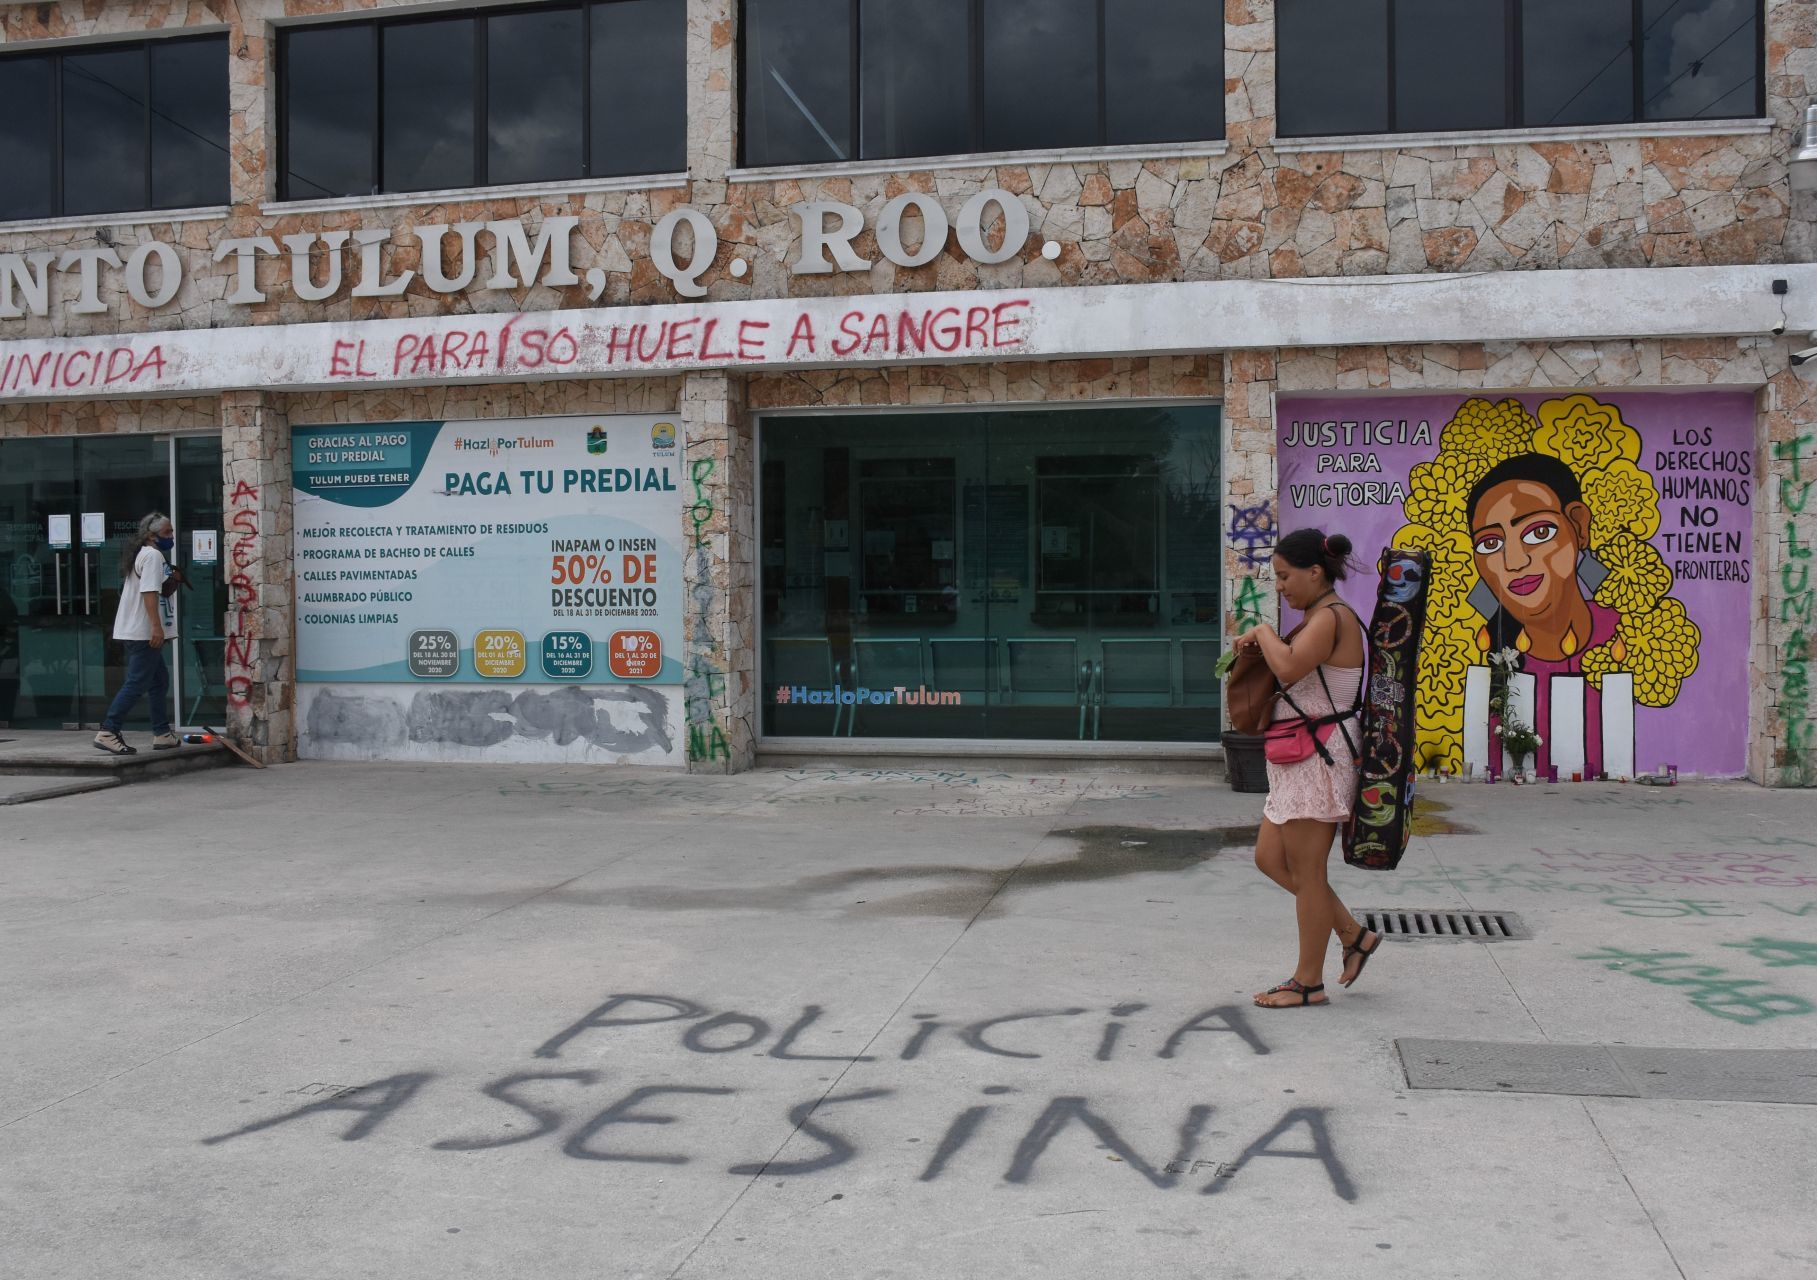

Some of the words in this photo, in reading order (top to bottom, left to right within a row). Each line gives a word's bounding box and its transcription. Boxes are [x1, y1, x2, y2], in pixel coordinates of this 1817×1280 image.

[0, 240, 182, 318] NTO
[213, 215, 607, 304] TULUM,
[649, 208, 748, 298] Q.
[791, 188, 1061, 274] ROO.
[329, 339, 377, 378] EL
[608, 317, 769, 364] HUELE
[786, 312, 816, 358] A
[832, 300, 1030, 357] SANGRE
[308, 437, 356, 449] GRACIAS
[359, 435, 372, 447] AL
[375, 434, 407, 446] PAGO
[1283, 420, 1432, 447] JUSTICIA
[1673, 427, 1712, 446] LOS
[309, 452, 322, 463] DE
[324, 452, 338, 463] TU
[342, 450, 385, 462] PREDIAL
[1317, 453, 1382, 473] PARA
[1655, 450, 1750, 476] DERECHOS
[309, 475, 342, 485] TULUM
[344, 474, 376, 484] PUEDE
[378, 473, 410, 483] TENER
[445, 471, 512, 496] PAGA
[520, 470, 554, 494] TU
[563, 467, 676, 493] PREDIAL
[1290, 481, 1407, 509] VICTORIA
[1662, 476, 1750, 506] HUMANOS
[1680, 505, 1719, 528] NO
[303, 528, 336, 538] MEJOR
[339, 526, 393, 537] RECOLECTA
[396, 526, 402, 536] Y
[405, 525, 477, 536] TRATAMIENTO
[480, 524, 493, 534] DE
[496, 523, 549, 534] RESIDUOS
[552, 539, 601, 552] INAPAM
[604, 538, 615, 551] O
[619, 538, 656, 551] INSEN
[1661, 531, 1741, 553] TIENEN
[303, 549, 361, 559] PROGRAMA
[364, 549, 377, 558] DE
[380, 548, 420, 558] BACHEO
[424, 547, 436, 557] DE
[440, 546, 475, 557] CALLES
[303, 571, 337, 581] CALLES
[340, 569, 418, 580] PAVIMENTADAS
[551, 554, 612, 585] 50%
[623, 554, 656, 583] DE
[1674, 559, 1750, 583] FRONTERAS
[304, 592, 367, 602] ALUMBRADO
[370, 589, 413, 602] PÚBLICO
[552, 588, 657, 607] DESCUENTO
[304, 614, 356, 624] COLONIAS
[359, 613, 399, 624] LIMPIAS
[418, 635, 452, 650] 25%
[484, 635, 519, 650] 20%
[551, 636, 583, 650] 15%
[776, 684, 961, 705] #HazloPorTulum
